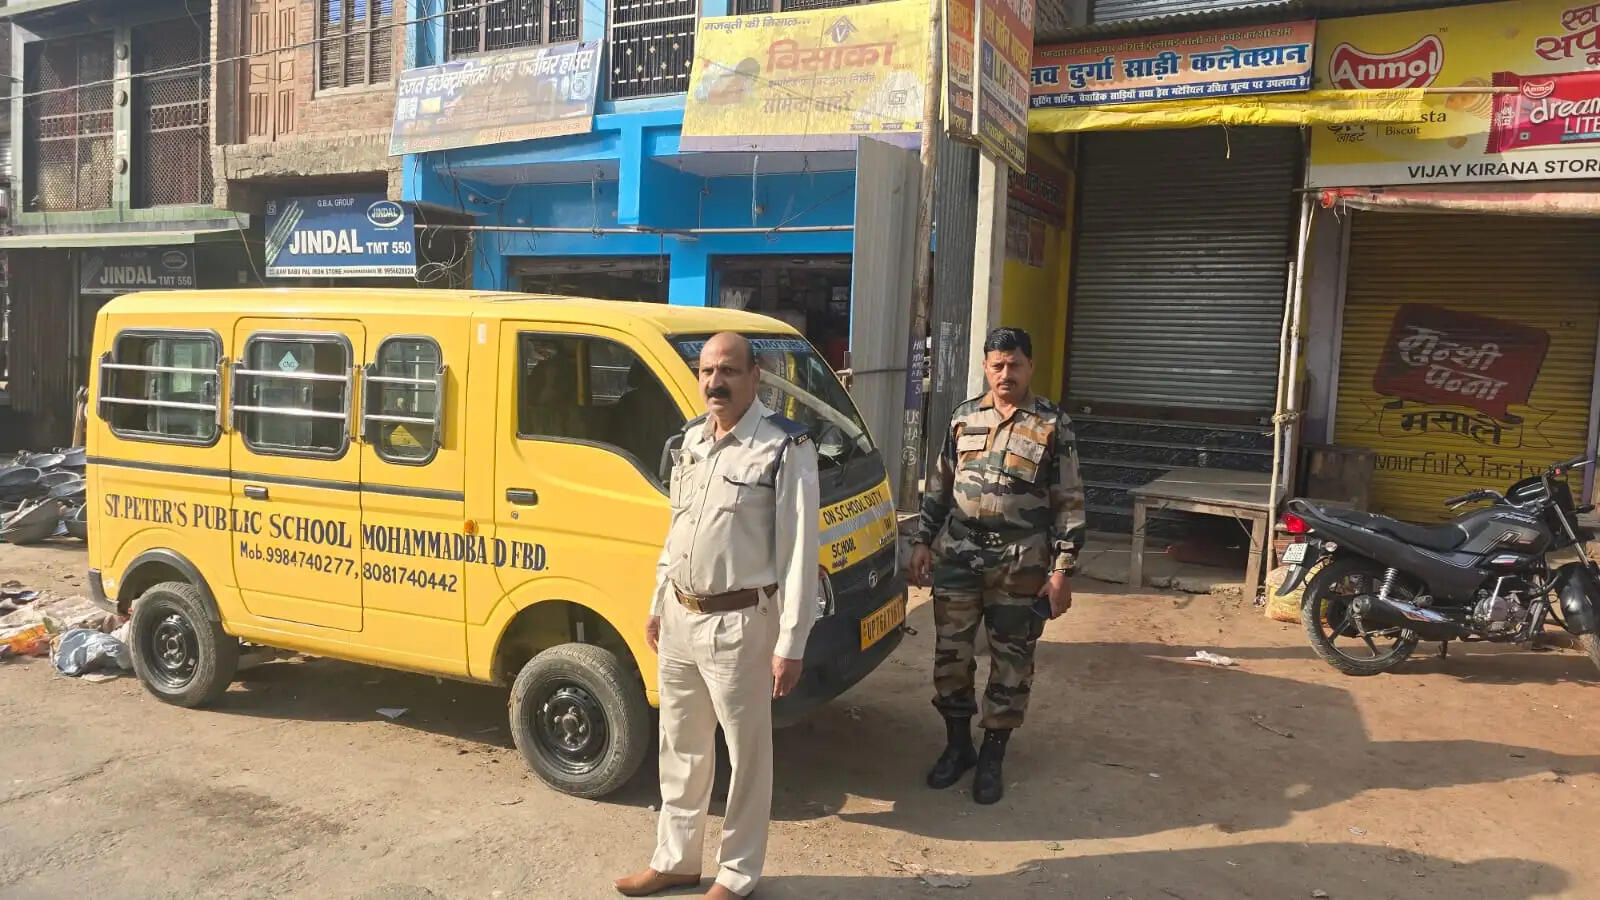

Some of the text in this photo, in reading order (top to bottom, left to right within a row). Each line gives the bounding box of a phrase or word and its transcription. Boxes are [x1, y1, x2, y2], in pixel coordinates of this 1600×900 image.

[745, 17, 760, 30] की
[1067, 52, 1115, 88] दुर्गा
[1124, 51, 1181, 81] साड़ी
[1190, 43, 1310, 72] कलेक्शन
[1334, 51, 1438, 82] Anmol
[1207, 82, 1228, 93] उचित
[1230, 81, 1250, 93] मूल्य
[1252, 80, 1264, 89] पर
[1385, 125, 1421, 136] Biscuit
[1408, 158, 1600, 179] VIJAY KIRANA STOR
[371, 206, 399, 218] JINDAL
[288, 229, 411, 255] JINDAL TMT 550
[99, 264, 192, 286] JINDAL TMT 550
[1455, 454, 1474, 477] &
[823, 488, 883, 526] ON SCHOOL DUTY
[192, 503, 262, 535] PUBLIC
[269, 513, 352, 548] SCHOOL
[831, 537, 857, 559] SCHOOL
[362, 562, 458, 593] 8081740442
